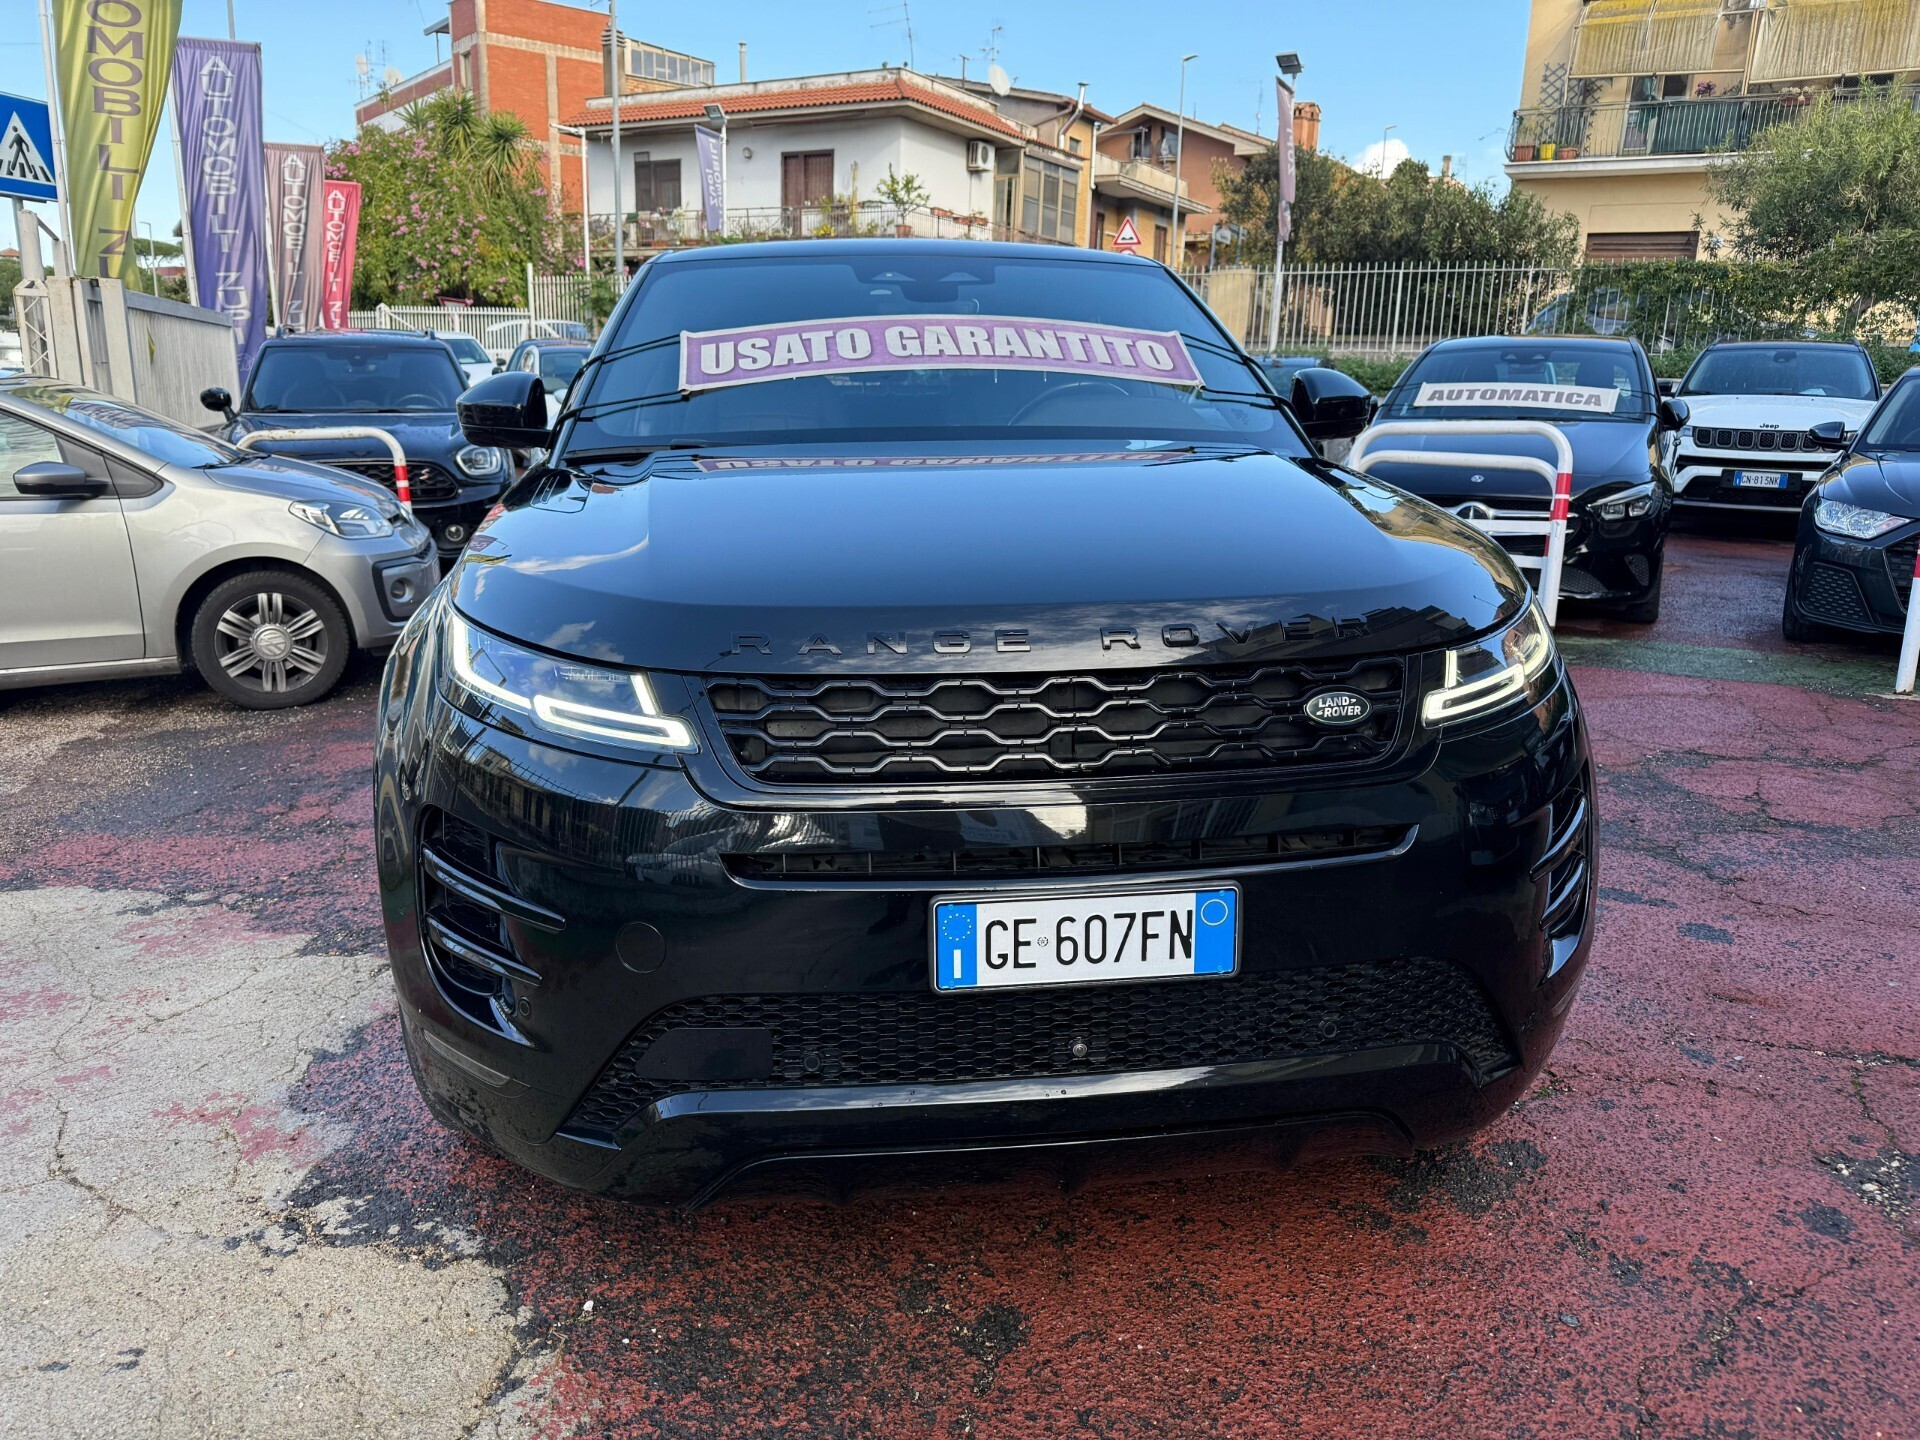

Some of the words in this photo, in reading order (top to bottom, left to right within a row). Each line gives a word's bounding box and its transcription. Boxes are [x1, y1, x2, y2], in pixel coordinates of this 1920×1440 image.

[199, 55, 239, 253] AUTOMOBILI
[700, 328, 872, 375] USATO
[884, 326, 1174, 371] GARANTITO
[1426, 388, 1602, 407] AUTOMATICA
[730, 629, 1031, 655] RANGE
[1100, 613, 1371, 650] ROVER
[1318, 696, 1349, 708] LAND
[1324, 705, 1361, 718] ROVER
[985, 918, 1037, 970] GE
[1055, 910, 1193, 966] 607FN
[953, 949, 962, 979] I
